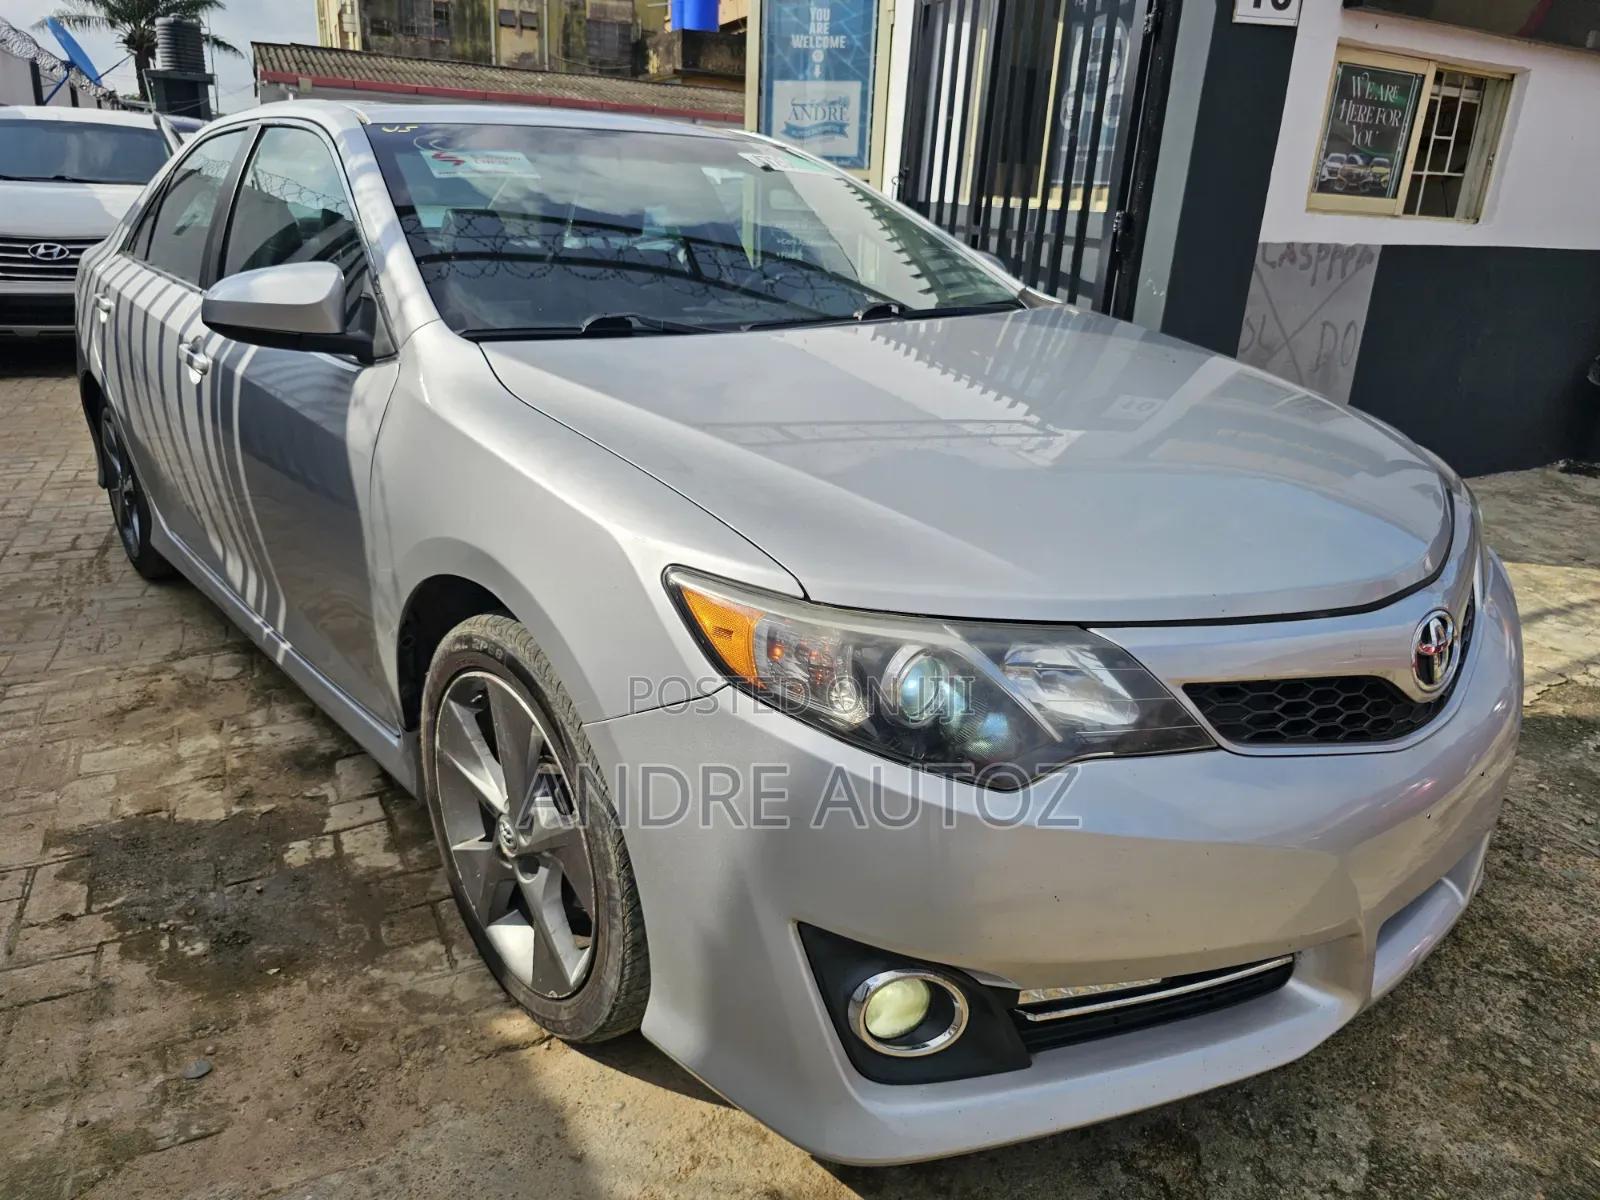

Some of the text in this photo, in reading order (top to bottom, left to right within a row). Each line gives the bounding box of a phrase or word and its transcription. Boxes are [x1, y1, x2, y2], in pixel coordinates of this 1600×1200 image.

[810, 8, 830, 21] YOU
[809, 22, 829, 34] ARE
[791, 34, 846, 48] WELCOME
[1352, 72, 1399, 102] WE ARE
[1339, 99, 1401, 127] HERE FOR
[1352, 124, 1379, 147] YOU
